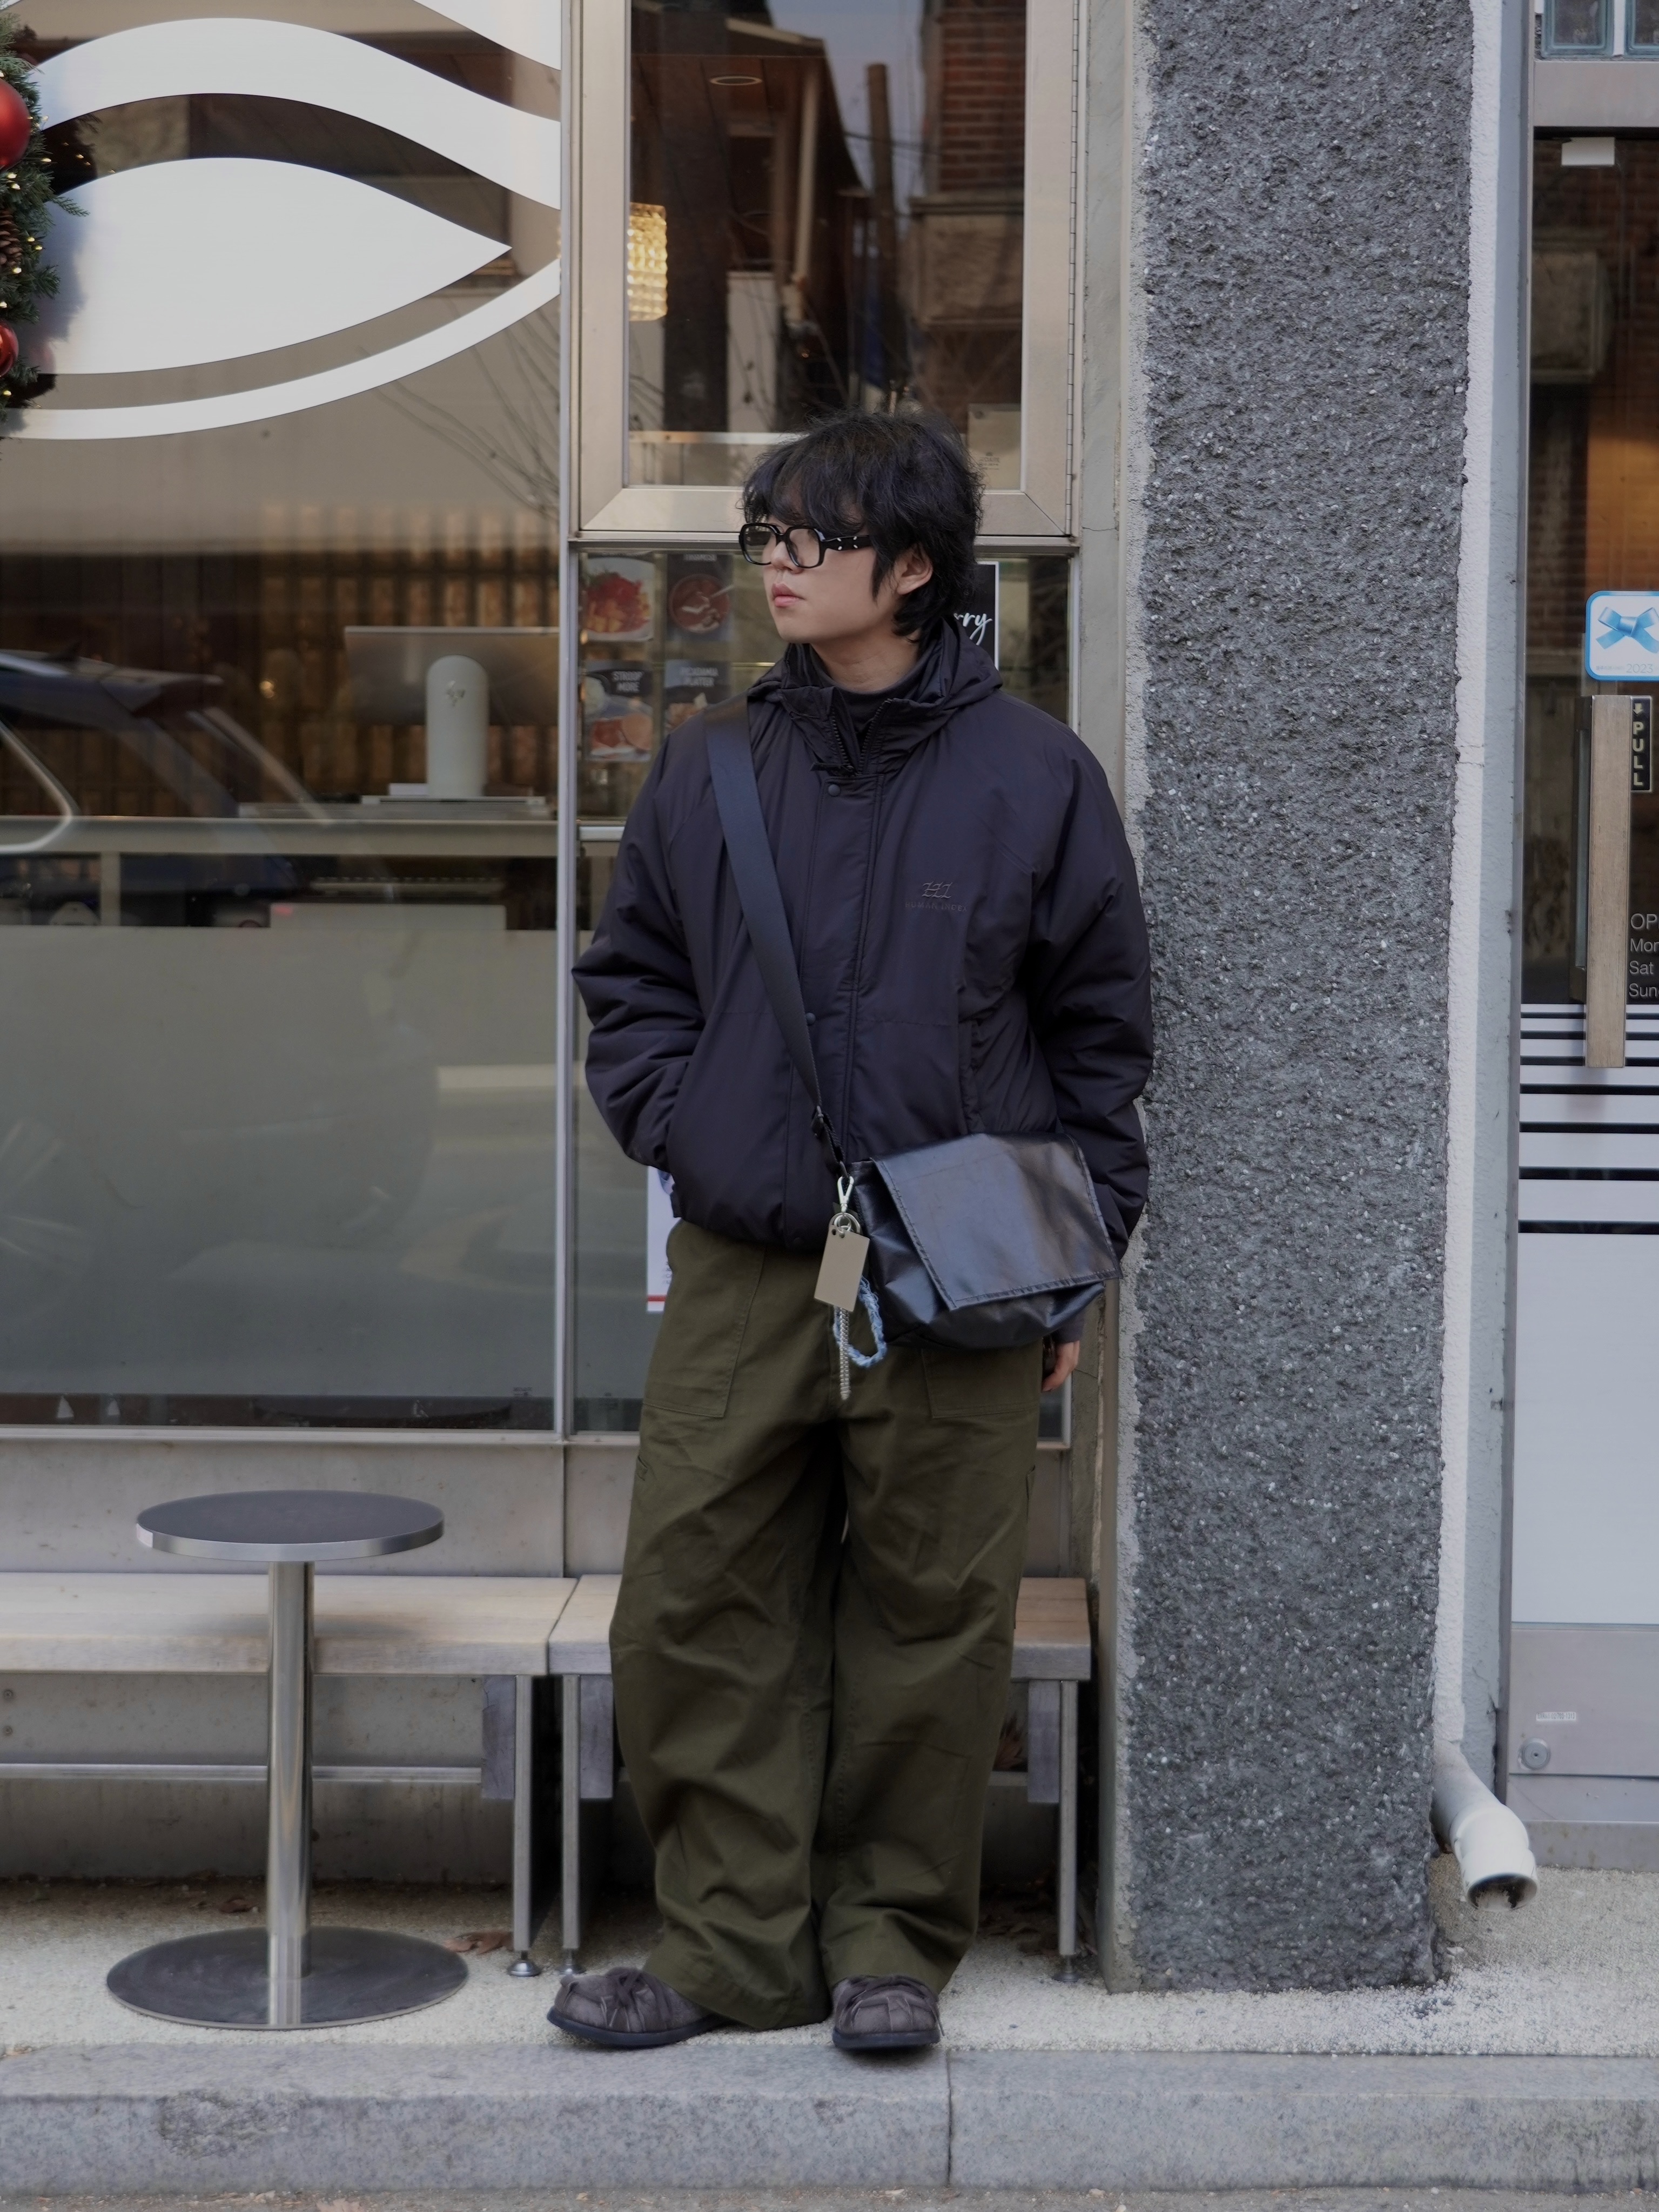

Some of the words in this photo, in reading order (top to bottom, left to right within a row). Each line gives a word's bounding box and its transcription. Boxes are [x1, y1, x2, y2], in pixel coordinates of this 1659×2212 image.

[1626, 663, 1654, 674] 2023
[1632, 721, 1644, 786] PULL
[905, 901, 938, 909] HUMAN
[941, 903, 967, 912] INDEX
[1630, 912, 1659, 930] OP
[1629, 960, 1654, 974] Sat
[1628, 983, 1659, 997] Sun
